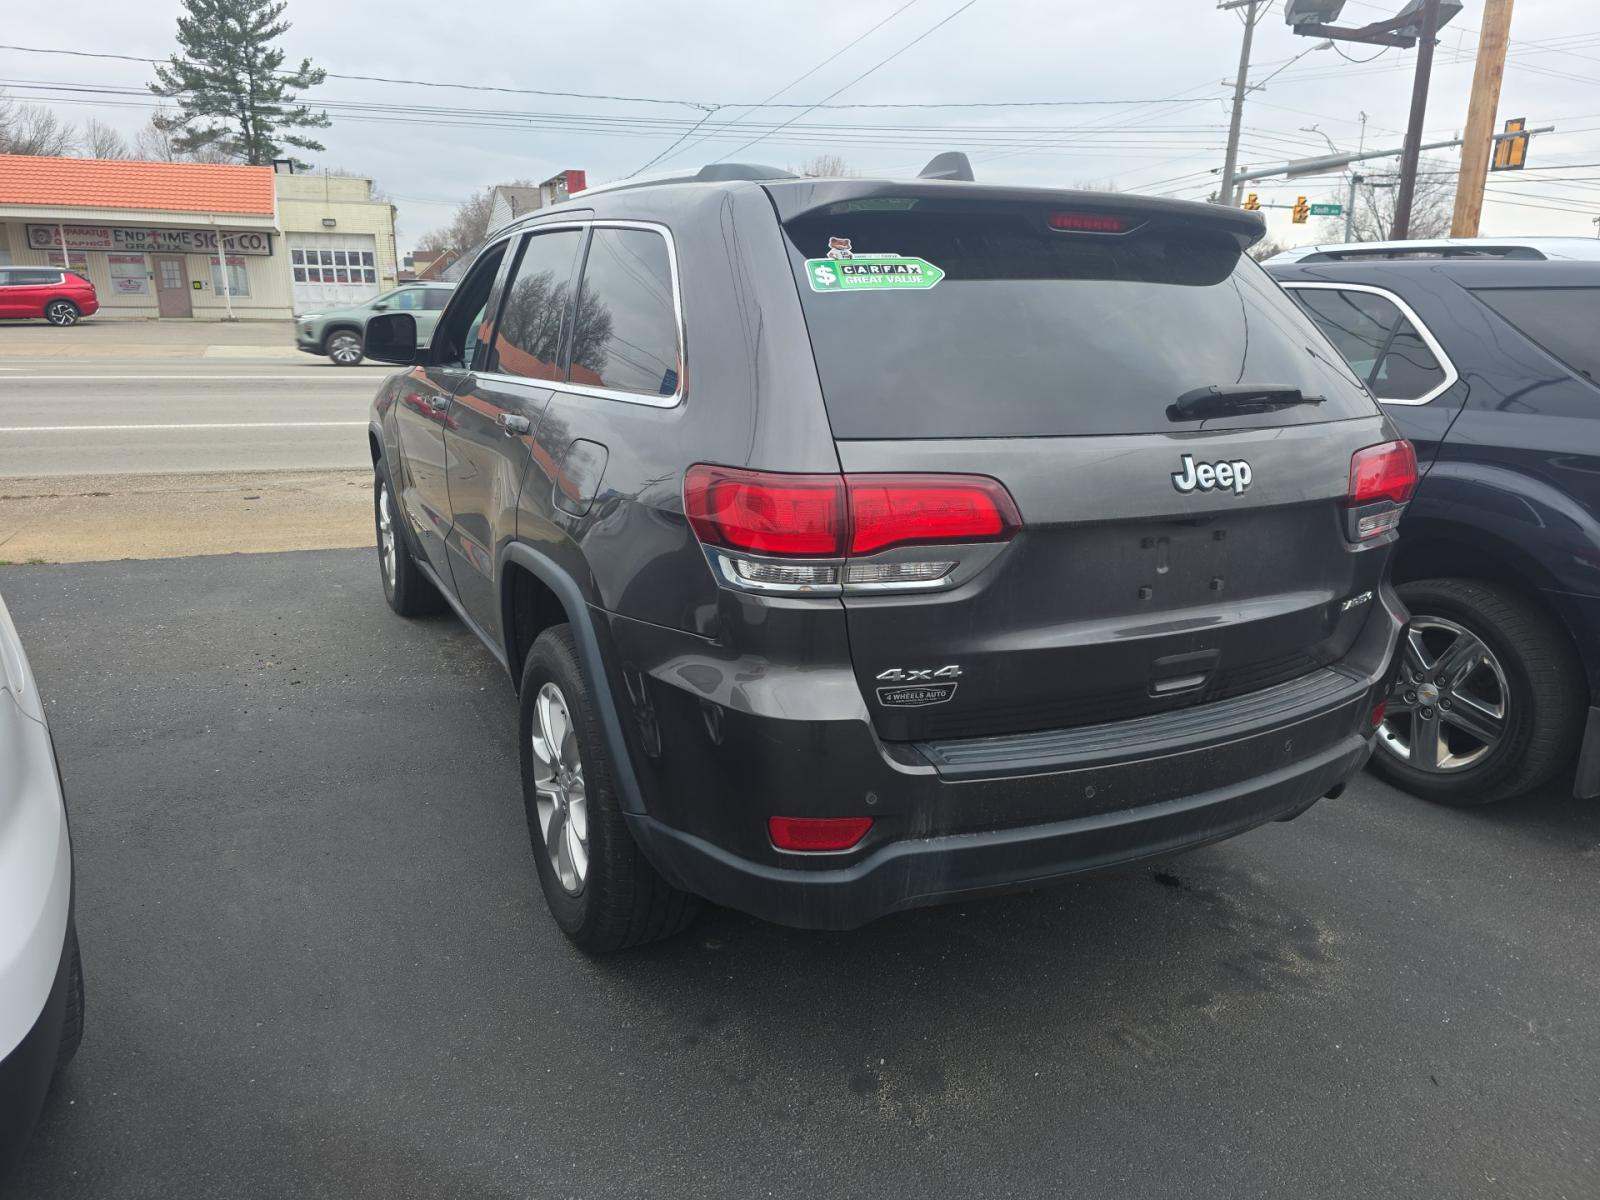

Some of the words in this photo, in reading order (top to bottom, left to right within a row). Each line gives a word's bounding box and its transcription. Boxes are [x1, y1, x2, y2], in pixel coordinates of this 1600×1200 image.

[194, 232, 235, 249] SIGN
[240, 234, 266, 250] CO.
[842, 264, 922, 275] CARFAX
[845, 275, 884, 284] GREAT
[886, 275, 924, 284] VALUE
[1171, 454, 1252, 496] Jeep
[876, 665, 963, 681] 4x4
[893, 692, 924, 701] WHEELS
[926, 690, 947, 698] AUTO
